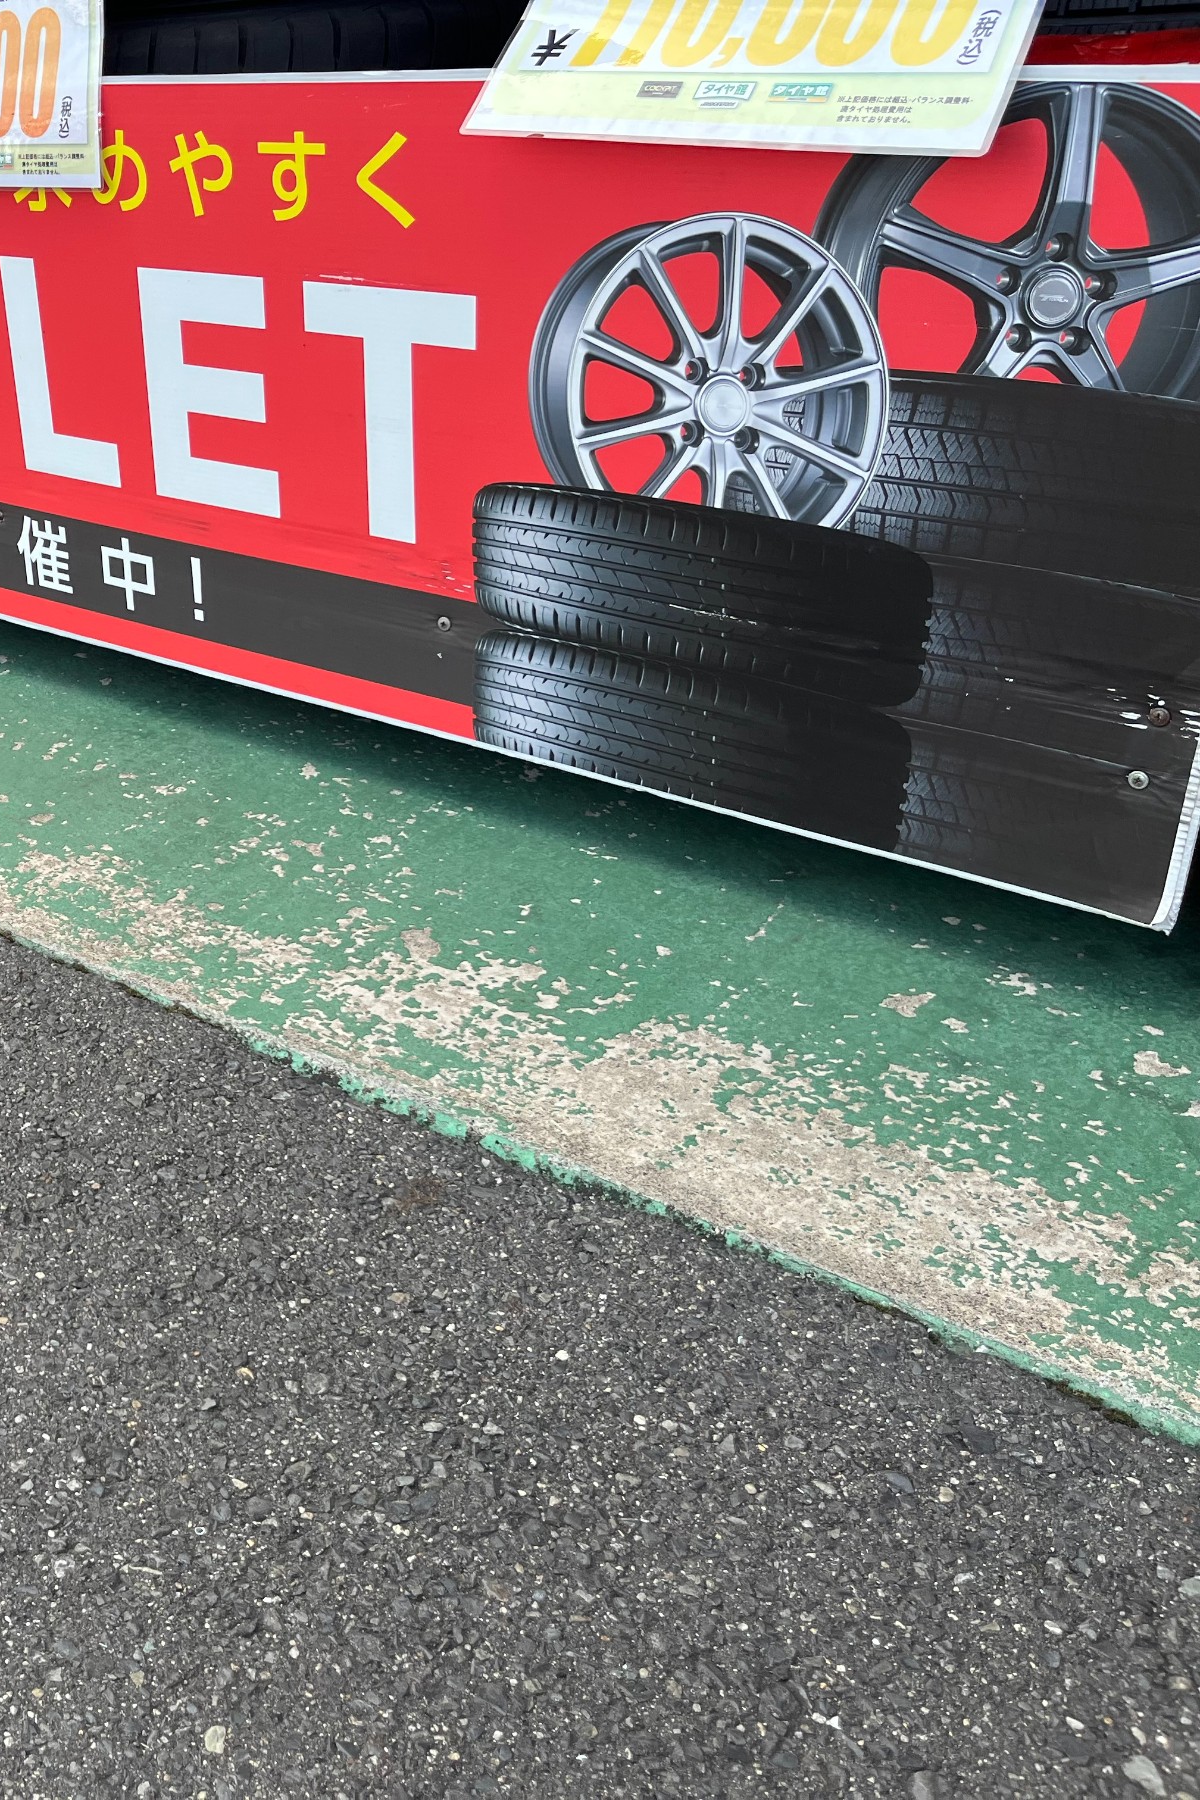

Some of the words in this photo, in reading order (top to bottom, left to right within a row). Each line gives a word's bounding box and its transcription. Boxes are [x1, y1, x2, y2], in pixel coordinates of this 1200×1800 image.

[703, 84, 749, 95] タイヤ館
[773, 85, 829, 96] タイヤ館
